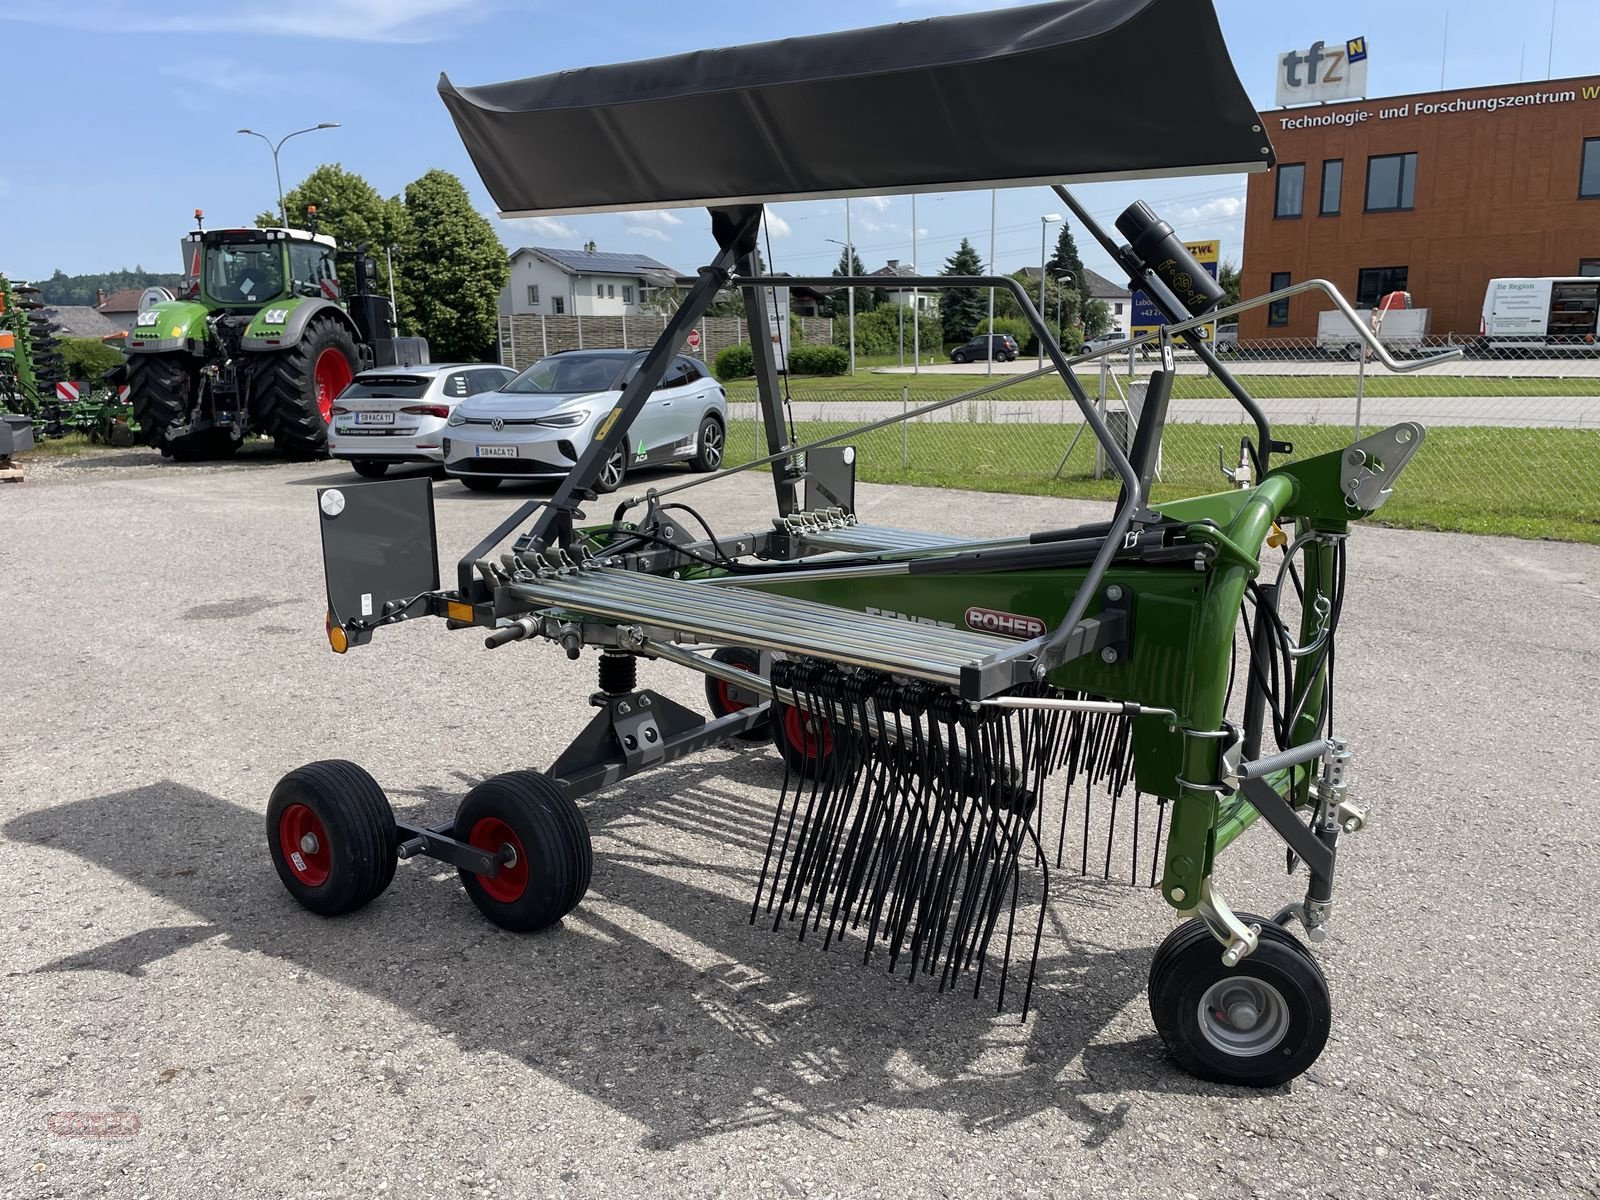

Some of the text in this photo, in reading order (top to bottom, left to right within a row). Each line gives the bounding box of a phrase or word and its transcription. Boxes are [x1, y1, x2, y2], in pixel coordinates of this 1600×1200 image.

[1348, 39, 1363, 55] N
[1282, 41, 1345, 87] tfz
[1279, 109, 1374, 130] Technologie-
[1379, 103, 1409, 119] und
[1413, 90, 1576, 115] Forschungszentrum
[635, 454, 648, 463] ACA
[969, 610, 1042, 638] ROHER
